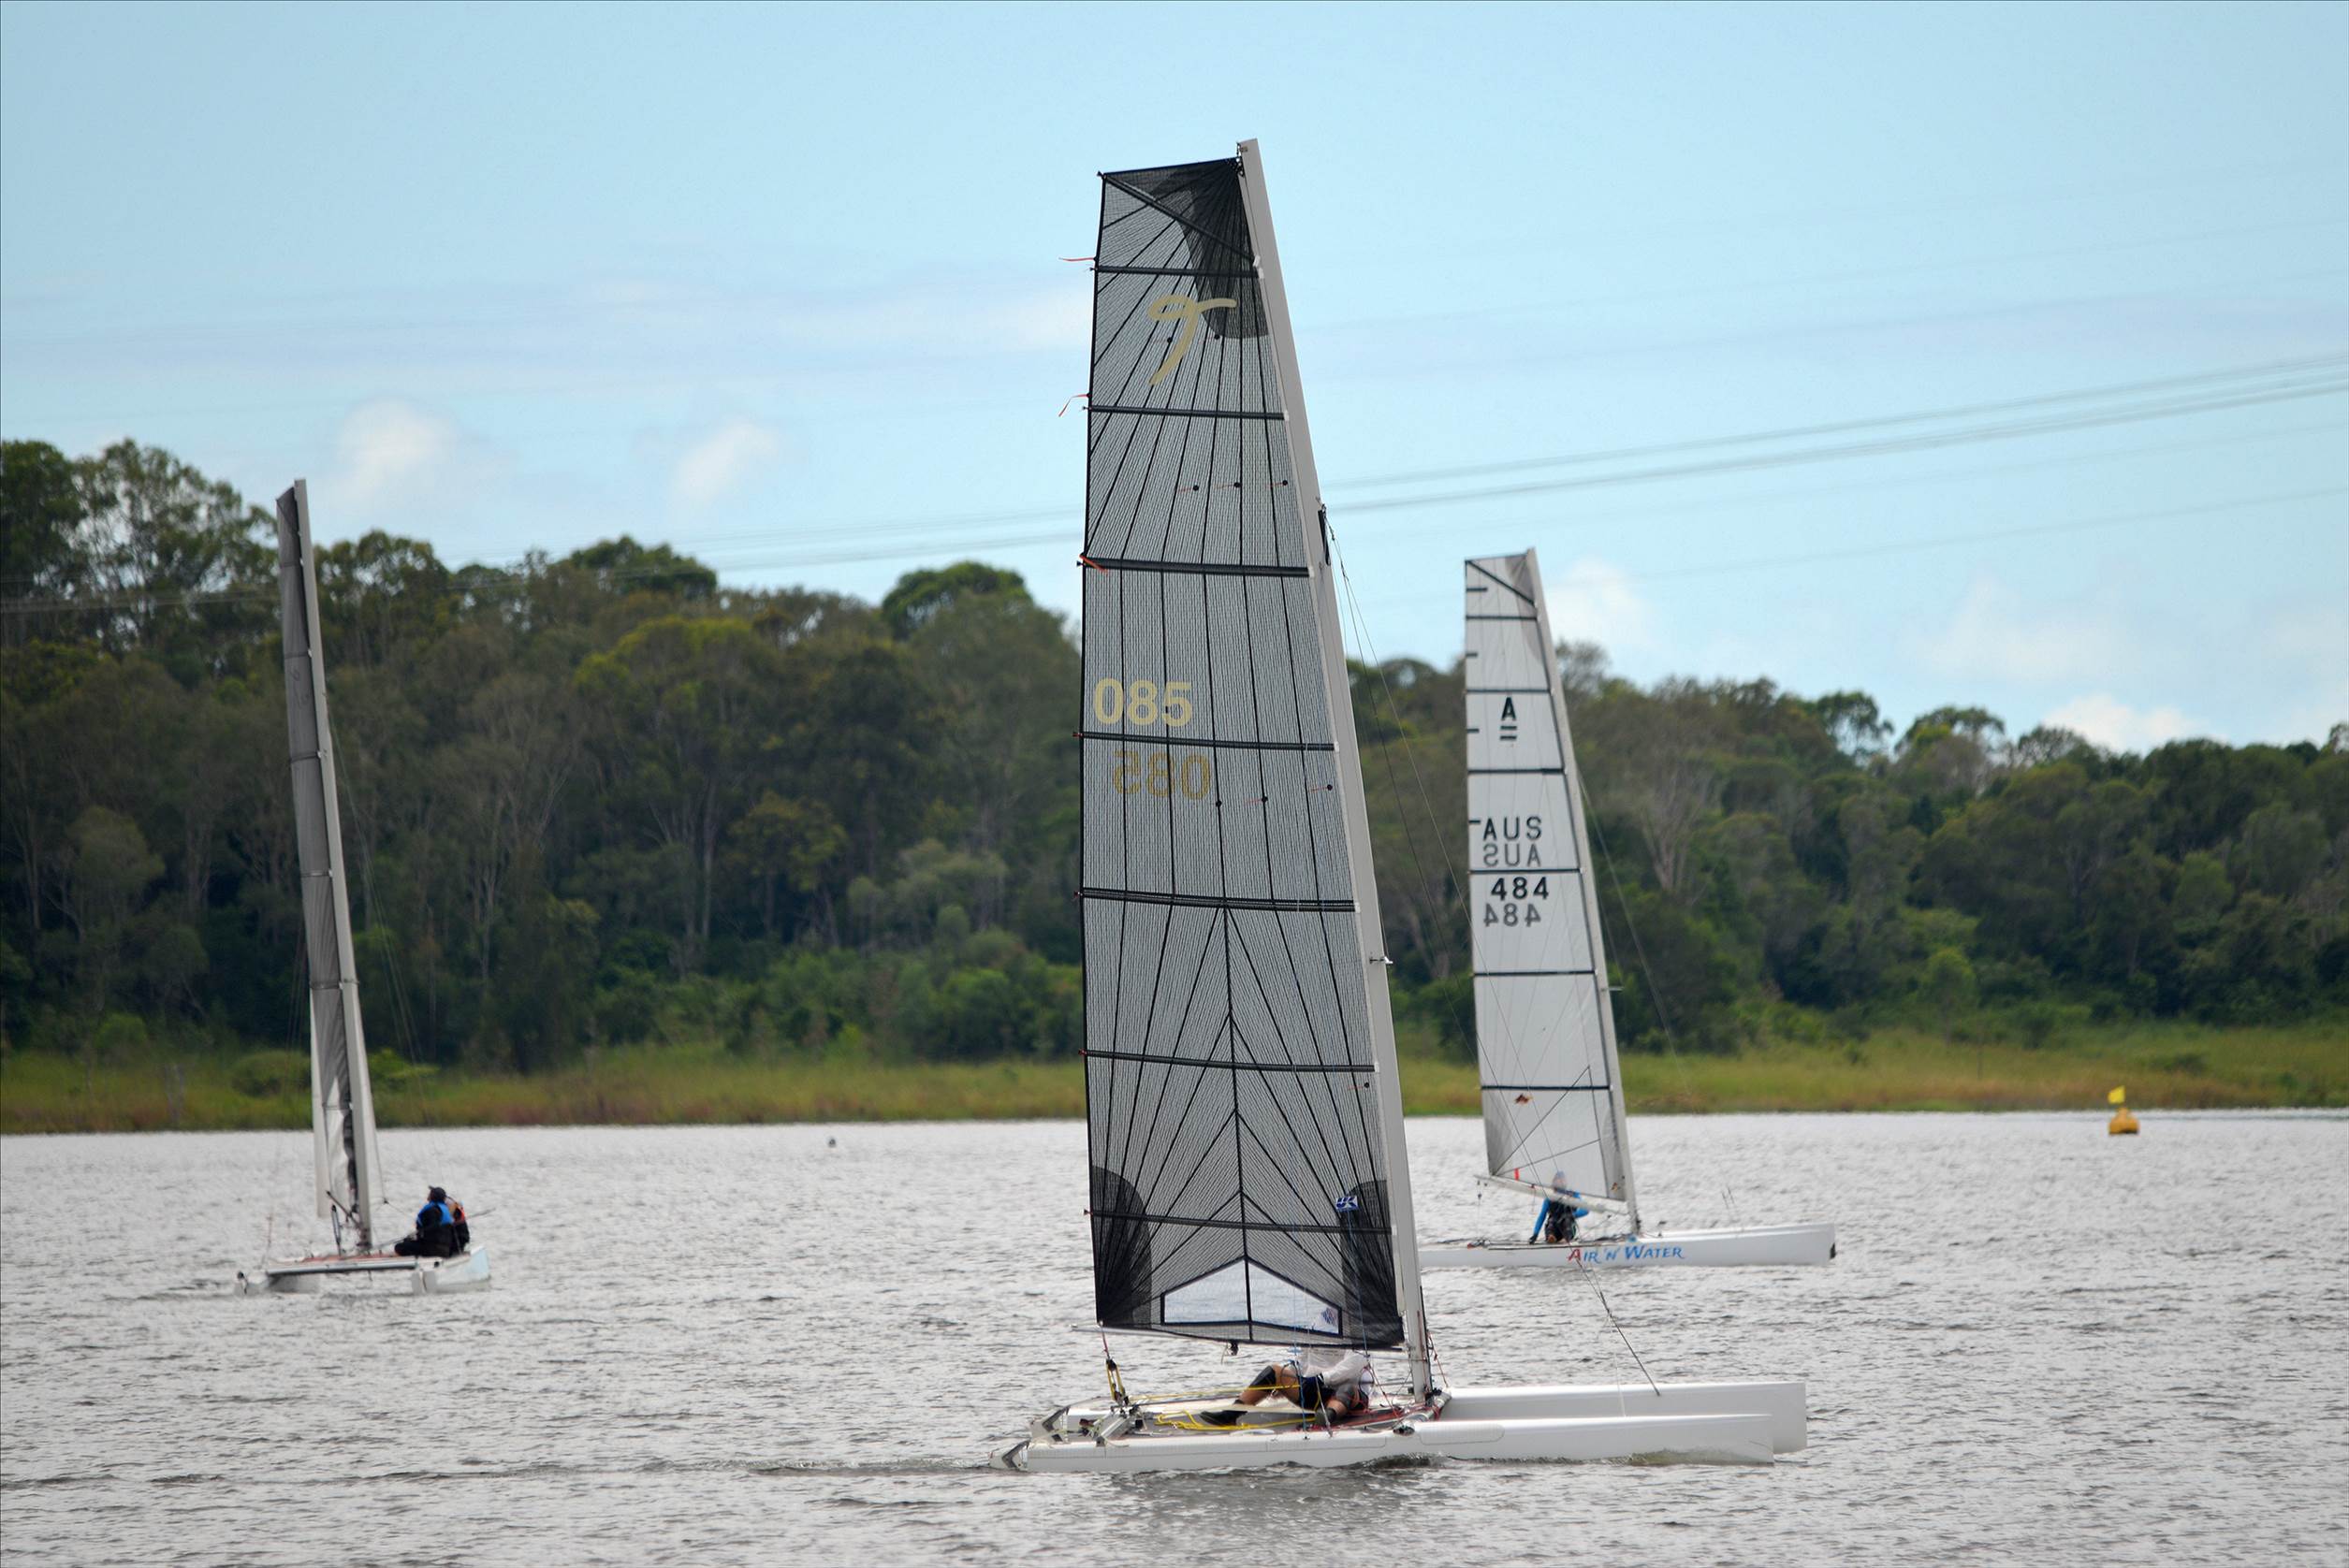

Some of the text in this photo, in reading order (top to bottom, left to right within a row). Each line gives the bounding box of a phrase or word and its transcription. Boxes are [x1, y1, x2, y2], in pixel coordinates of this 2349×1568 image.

[1094, 678, 1192, 727] 085
[1501, 696, 1517, 720] A
[1483, 816, 1541, 841] AUS
[1491, 877, 1549, 900] 484
[1624, 1245, 1685, 1259] WATER
